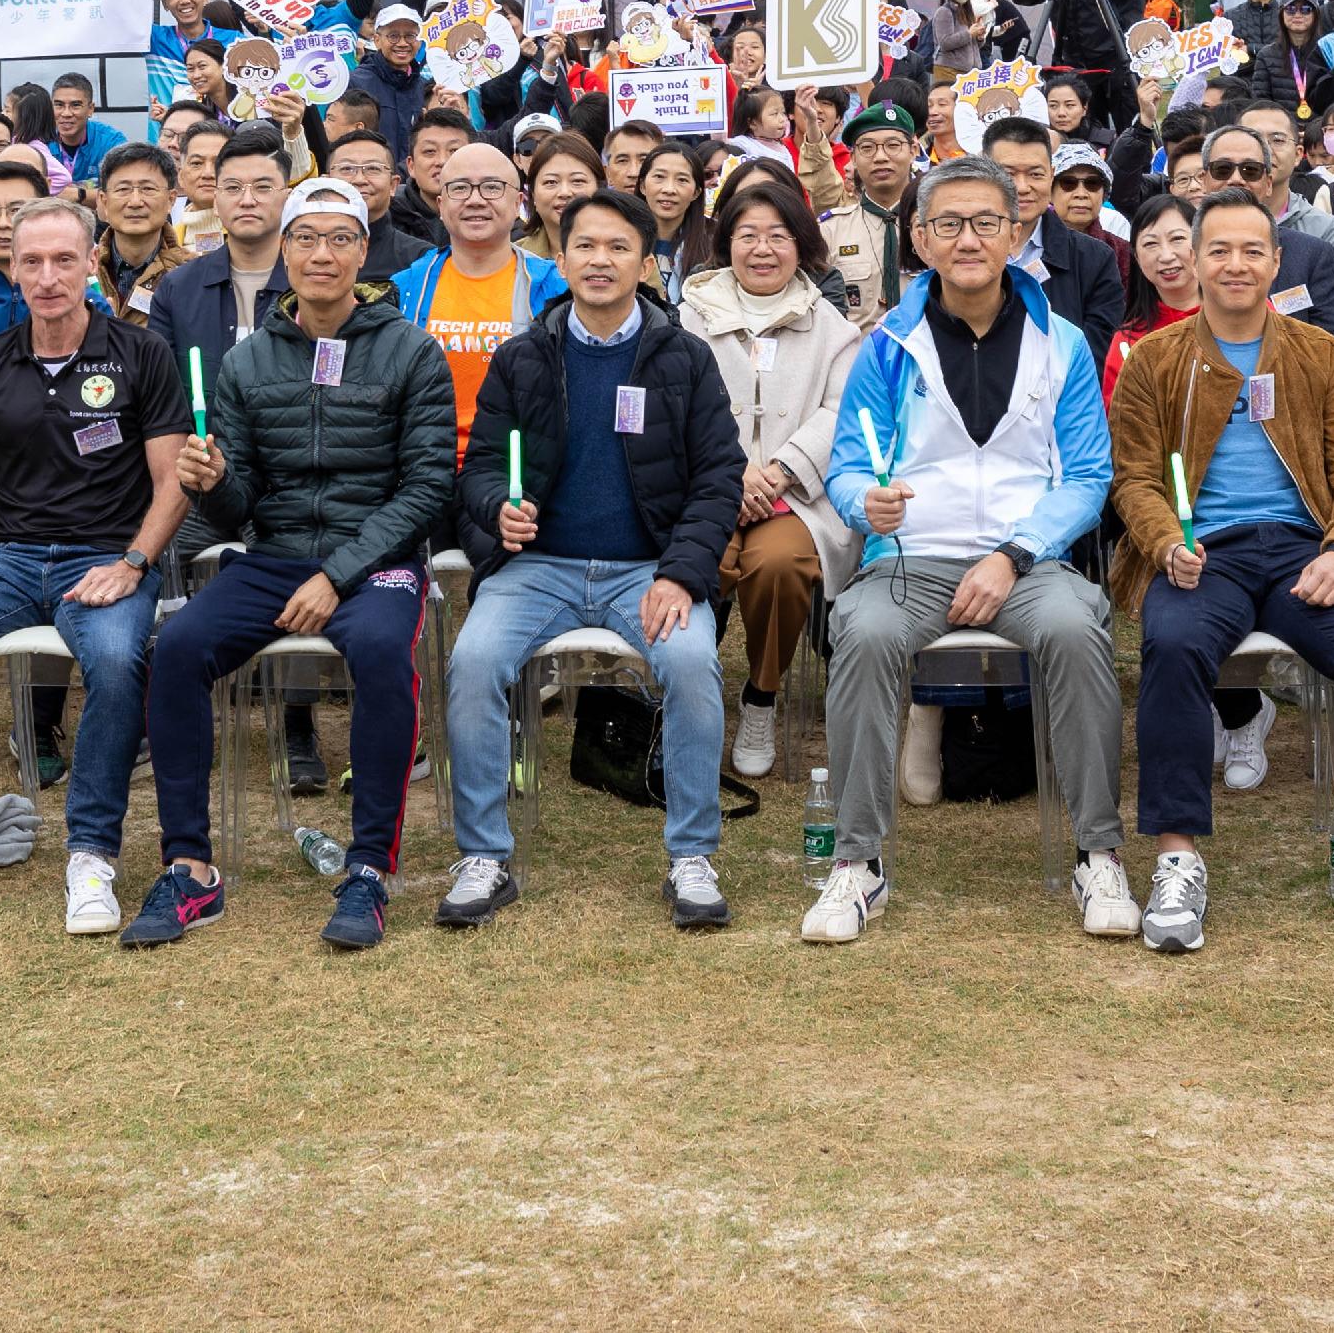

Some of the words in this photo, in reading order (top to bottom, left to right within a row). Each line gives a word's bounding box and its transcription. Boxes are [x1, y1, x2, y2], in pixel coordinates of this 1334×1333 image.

[284, 0, 312, 20] up
[878, 6, 904, 26] ES
[1177, 24, 1214, 53] YES
[1186, 52, 1196, 74] I
[637, 83, 664, 93] click
[667, 79, 689, 89] you
[653, 94, 689, 103] before
[655, 105, 690, 116] Think
[429, 320, 475, 333] TECH
[477, 321, 513, 333] FOR
